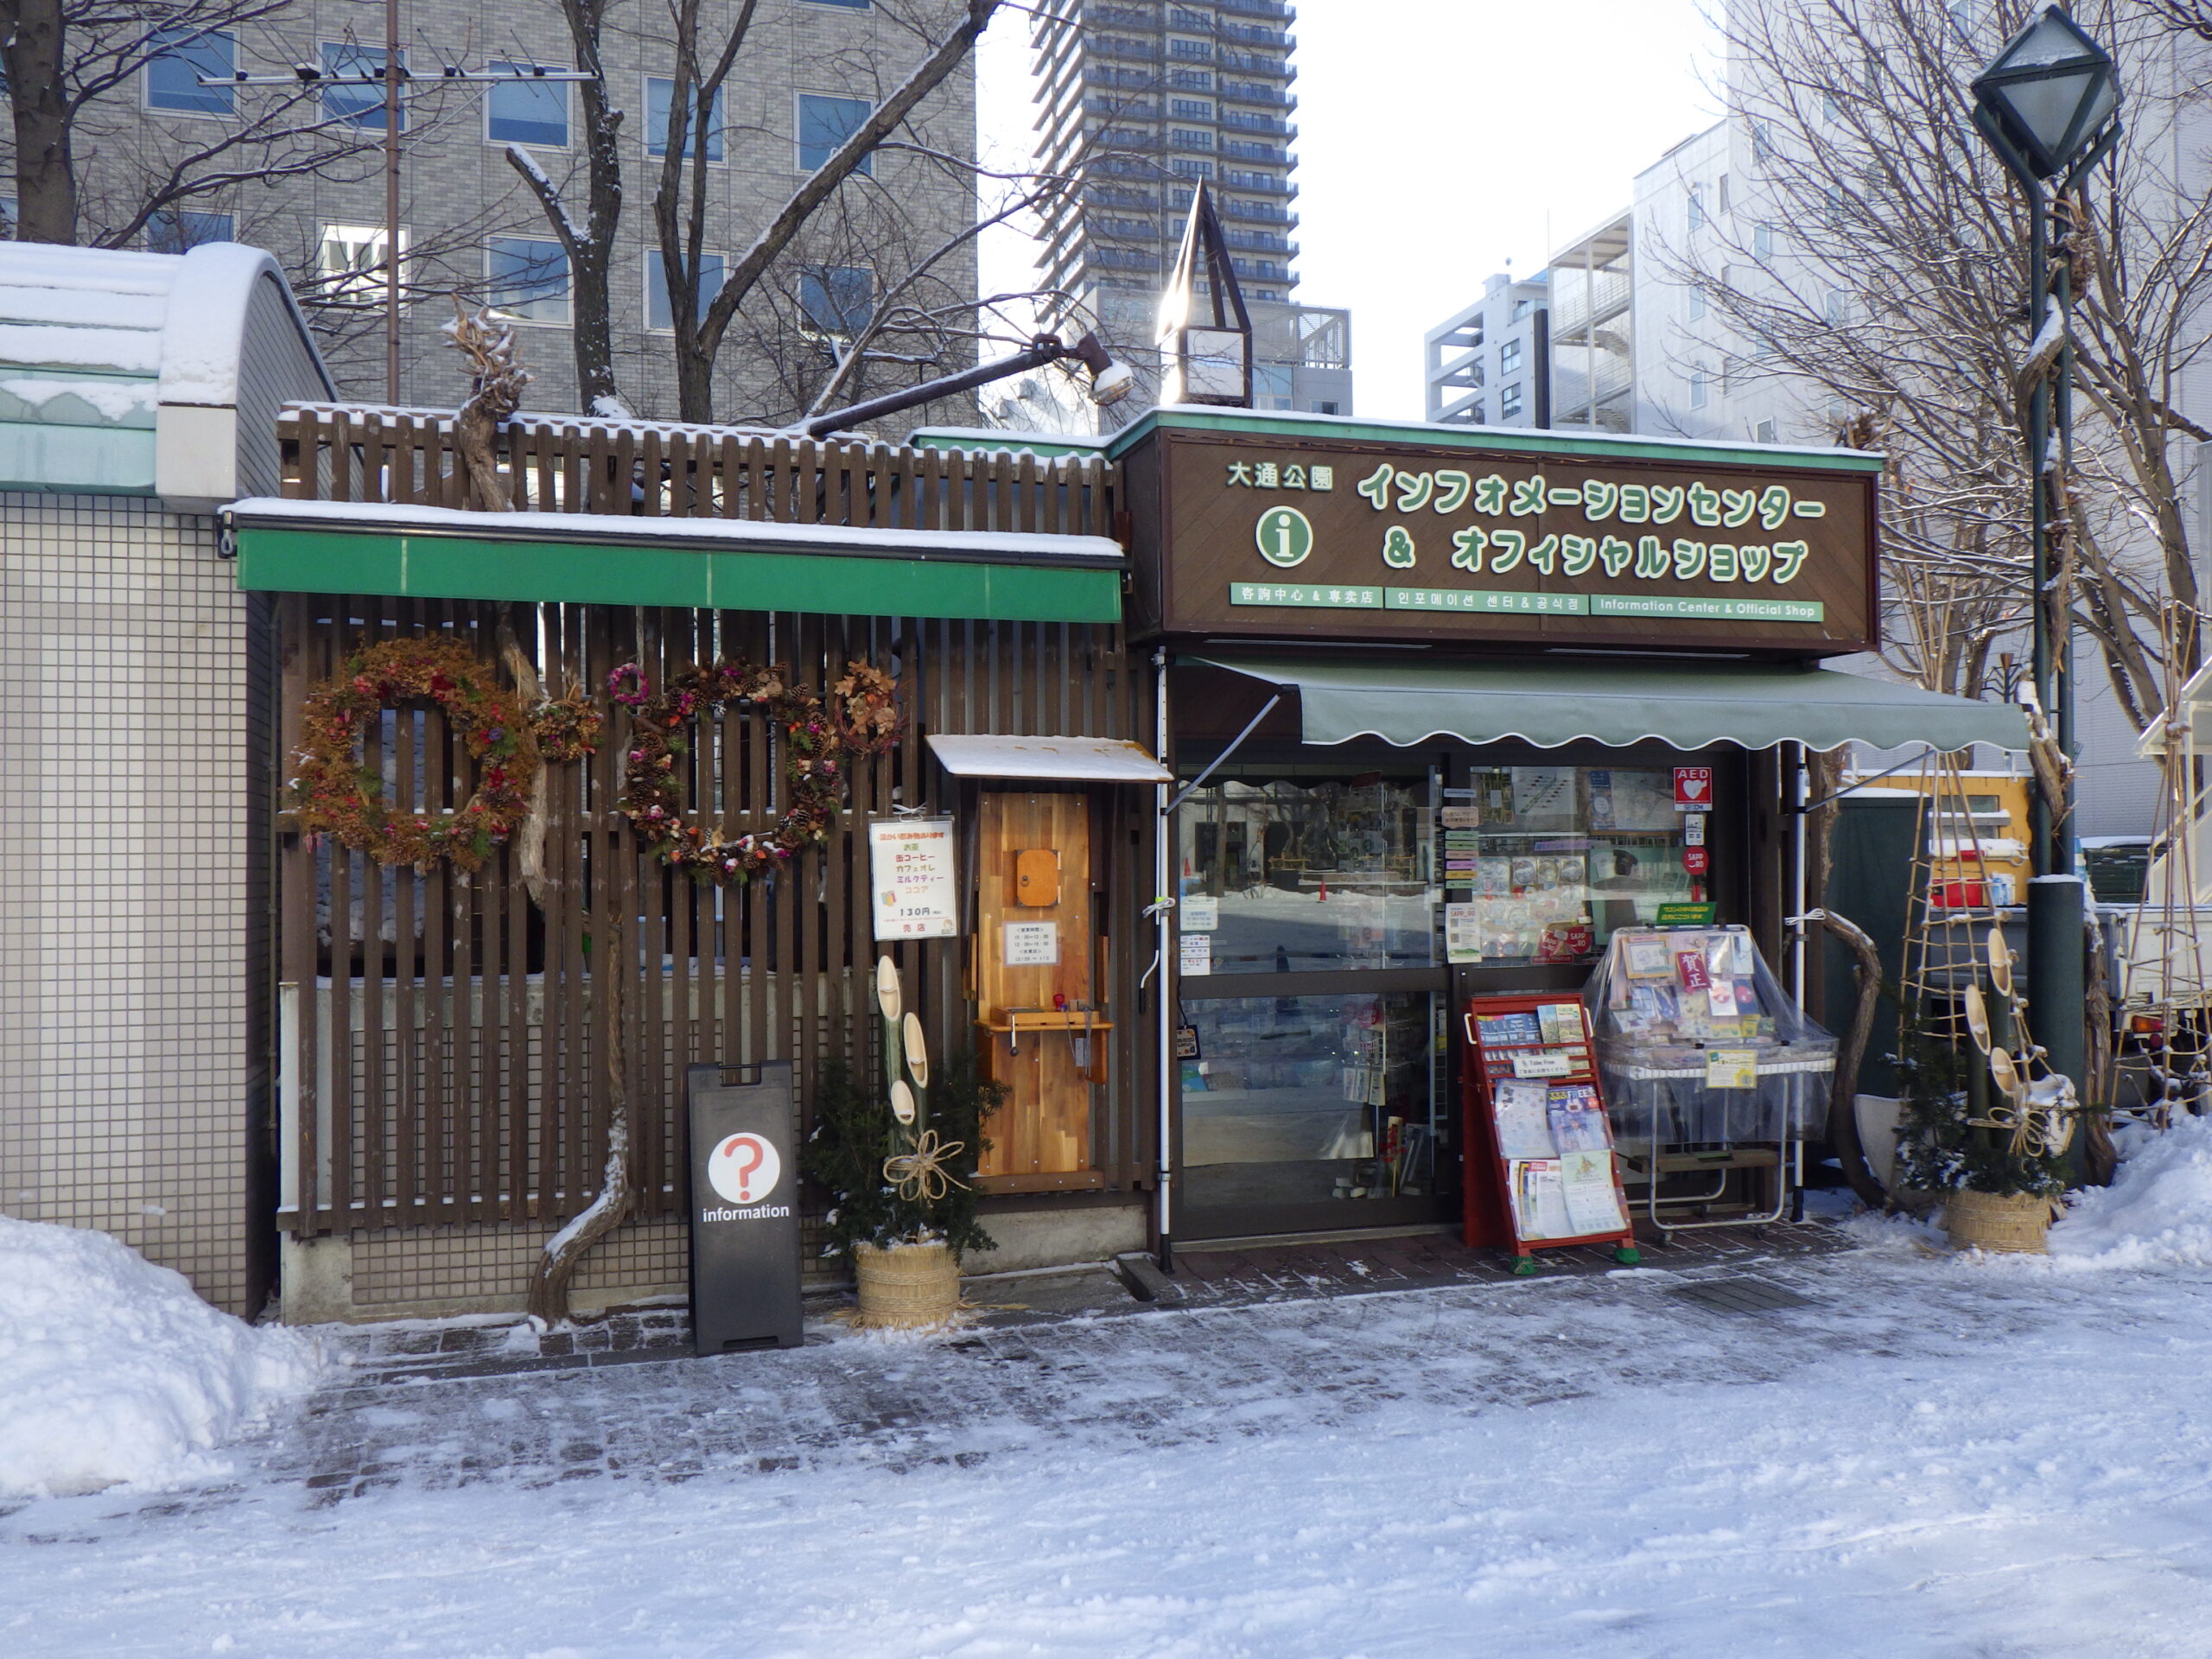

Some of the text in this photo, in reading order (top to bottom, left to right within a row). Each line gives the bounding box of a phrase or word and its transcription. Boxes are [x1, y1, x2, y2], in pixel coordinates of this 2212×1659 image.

[1226, 461, 1334, 492] 大通公園
[1357, 463, 1826, 531] インフォメーションセンター
[1383, 525, 1808, 584] & オフィシャルショップ
[1312, 591, 1321, 601] &
[1397, 591, 1474, 607] 인포메이션
[1600, 599, 1815, 618] Information Center & Official Shop
[1677, 769, 1708, 779] AED
[896, 854, 935, 862] 缶コーヒー
[896, 864, 935, 873] カフェオレ
[897, 874, 944, 884] ミルクティー
[905, 886, 929, 894] ココア
[1681, 953, 1707, 988] 賀正
[702, 1204, 790, 1223] information
